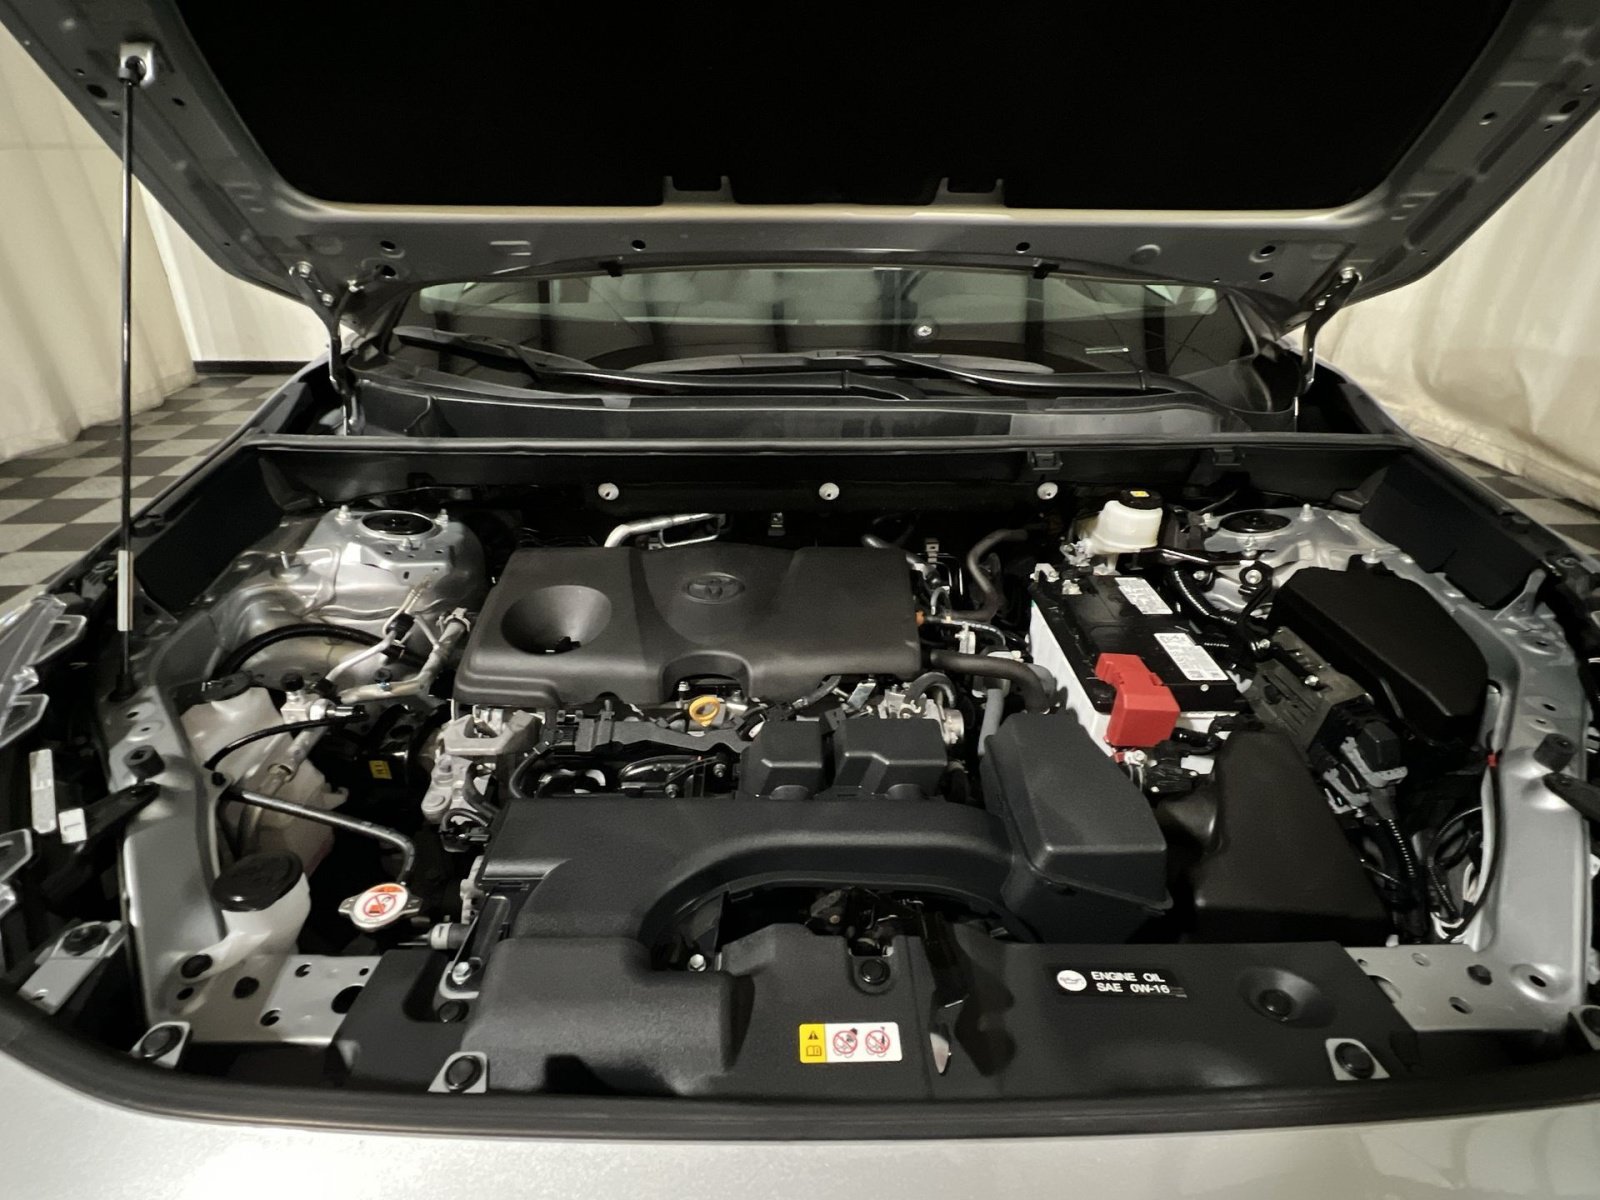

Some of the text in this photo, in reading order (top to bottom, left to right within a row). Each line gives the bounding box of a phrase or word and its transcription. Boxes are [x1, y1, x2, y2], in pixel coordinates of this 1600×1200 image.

[1091, 971, 1166, 983] ENGINE OIL
[1096, 983, 1171, 994] SAE 0W-16
